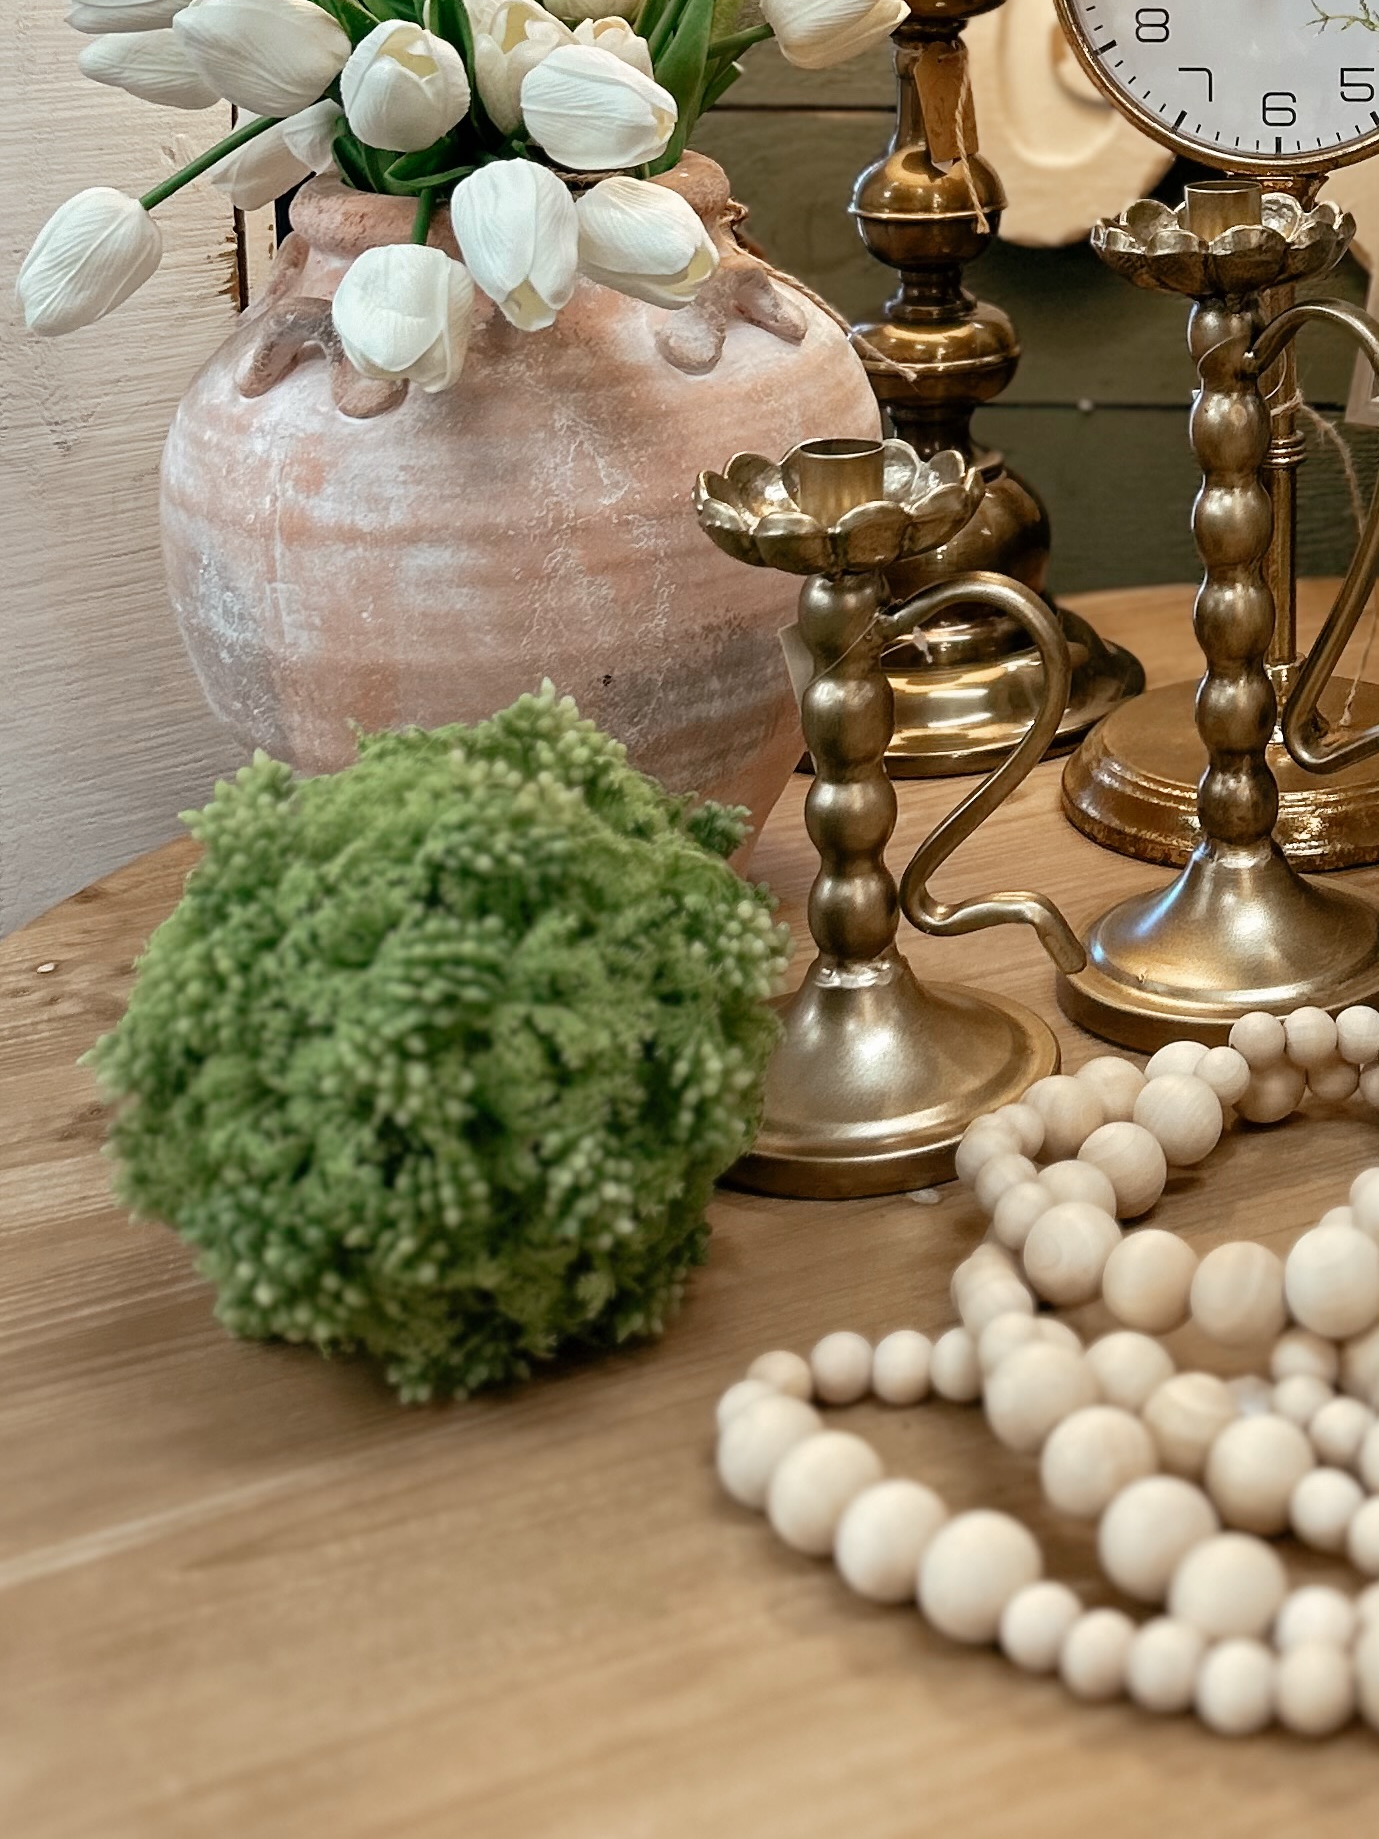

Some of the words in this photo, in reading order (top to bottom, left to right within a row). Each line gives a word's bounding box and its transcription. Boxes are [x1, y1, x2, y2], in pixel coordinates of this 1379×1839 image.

[1134, 7, 1170, 43] 8
[1177, 67, 1214, 103] 7
[1339, 67, 1376, 103] 5
[1261, 91, 1298, 128] 6
